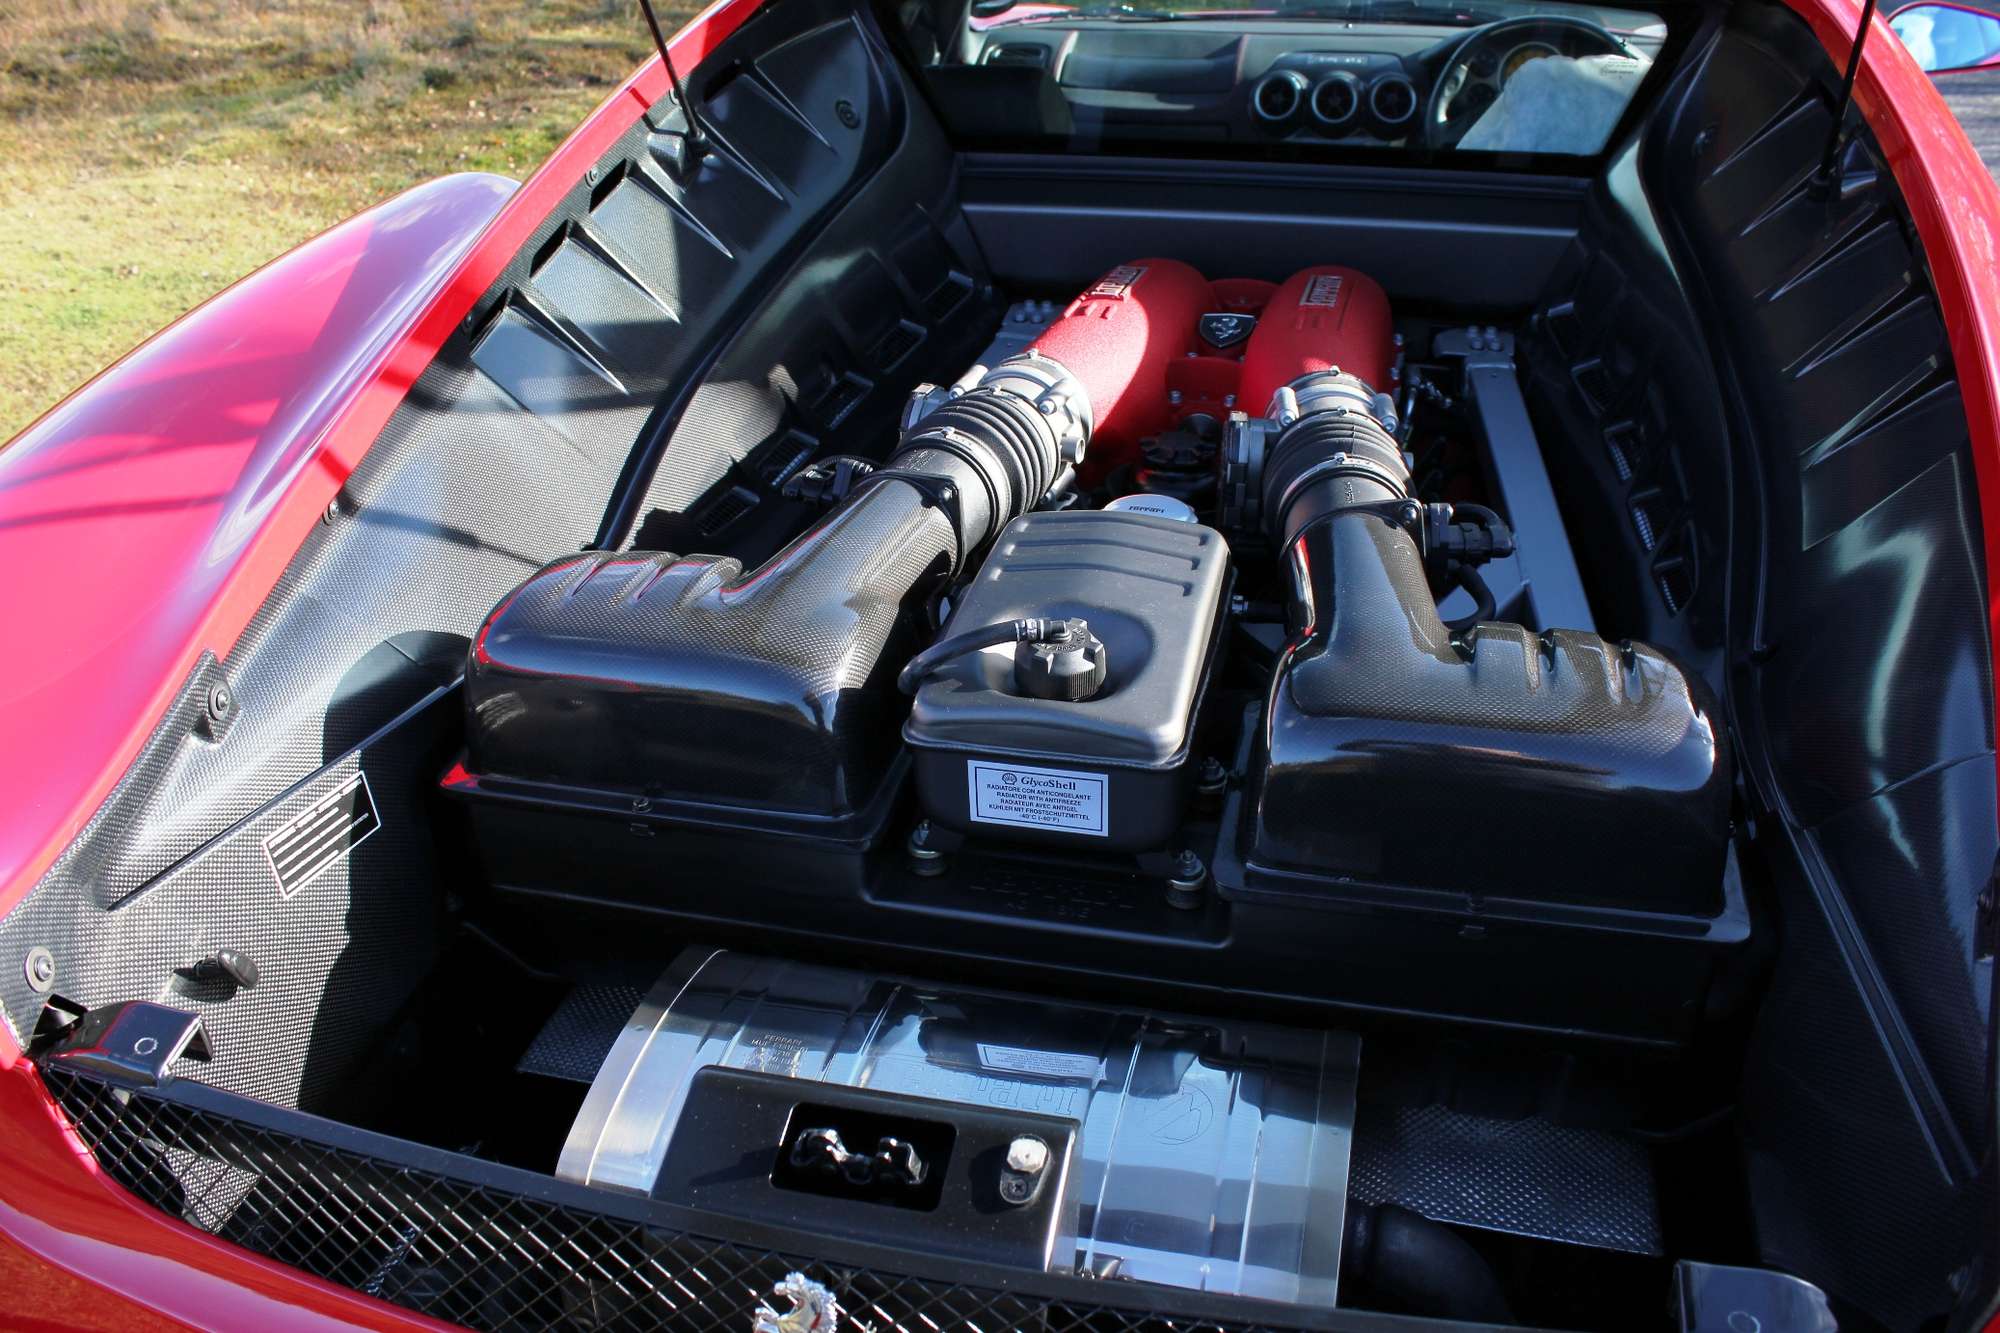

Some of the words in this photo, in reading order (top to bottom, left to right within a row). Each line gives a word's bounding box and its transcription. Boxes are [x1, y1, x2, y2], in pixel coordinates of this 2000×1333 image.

[1020, 775, 1077, 791] GlycoShell
[987, 783, 1021, 793] RADIATORE
[1021, 787, 1036, 795] CON
[1036, 789, 1092, 801] ANTICONGELANTE
[996, 791, 1027, 800] RADIATOR
[1028, 794, 1044, 802] WITH
[1044, 796, 1082, 806] ANTIFREEZE
[1000, 798, 1034, 807] RADIATEUR
[1052, 804, 1079, 813] ANTIGEL
[1025, 807, 1091, 820] FROSTSCHUTZMITTEL
